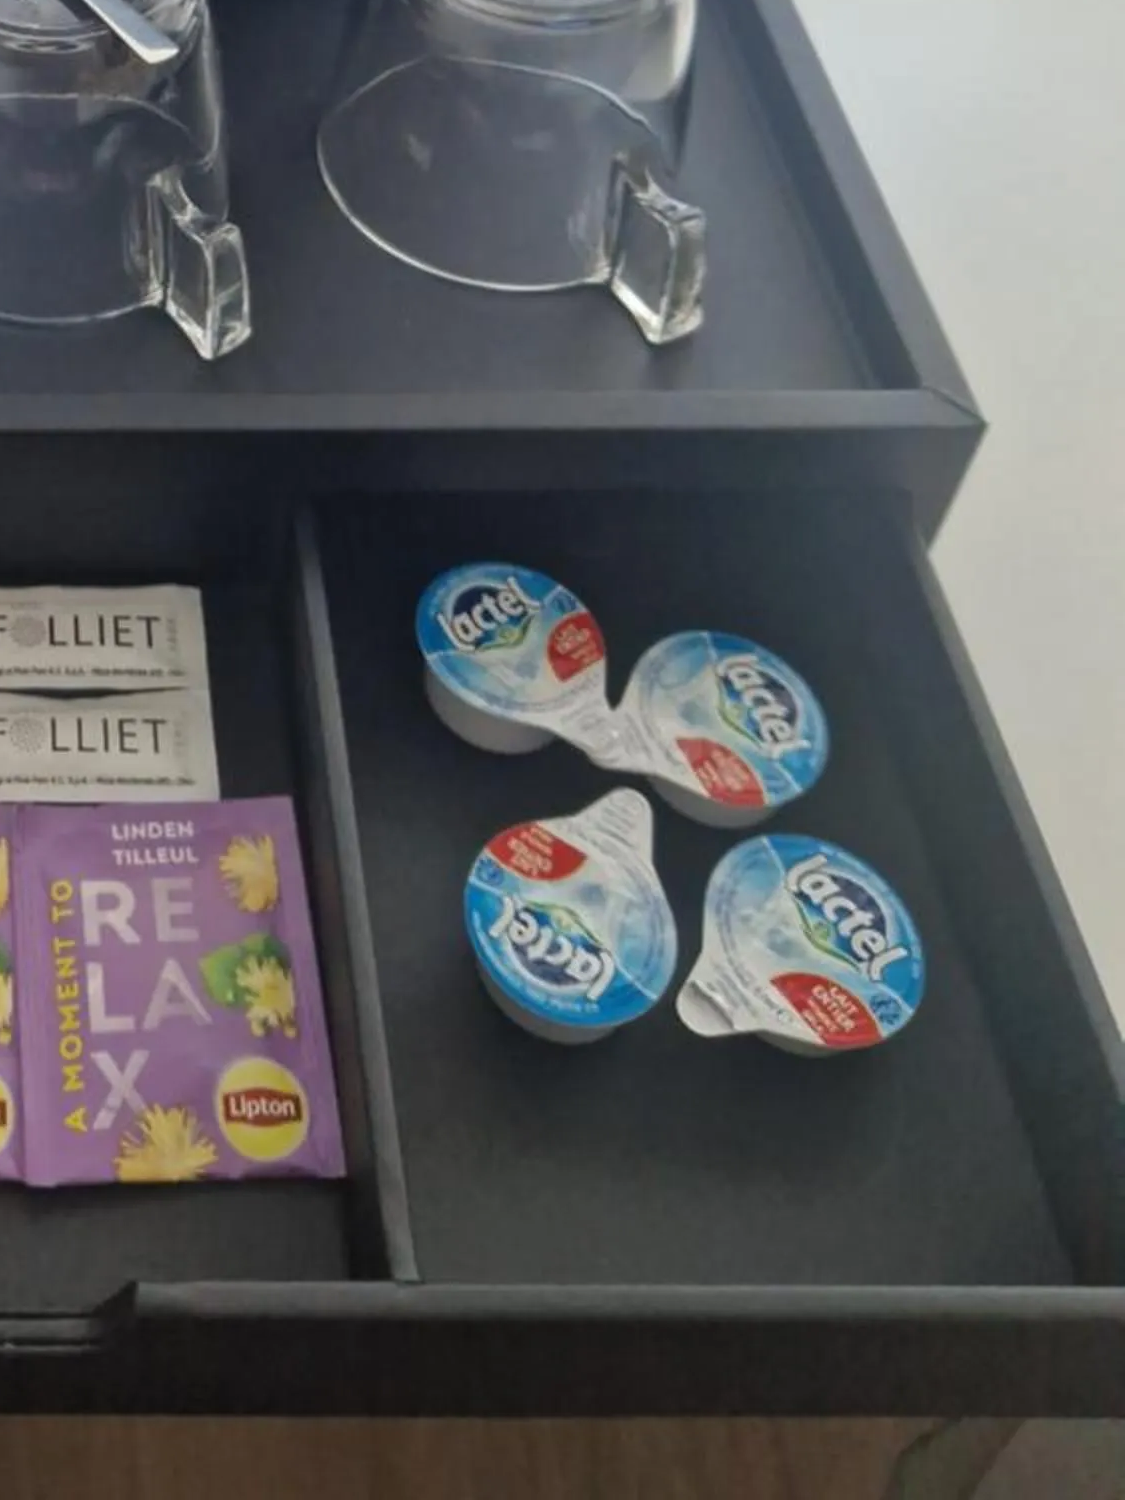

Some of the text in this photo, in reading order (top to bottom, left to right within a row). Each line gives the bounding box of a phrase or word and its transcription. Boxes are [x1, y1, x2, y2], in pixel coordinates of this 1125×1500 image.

[111, 821, 195, 841] LINDEN
[111, 847, 200, 867] TILLEUL
[50, 879, 88, 1132] A MOMENT TO
[228, 1096, 297, 1119] Lipton
